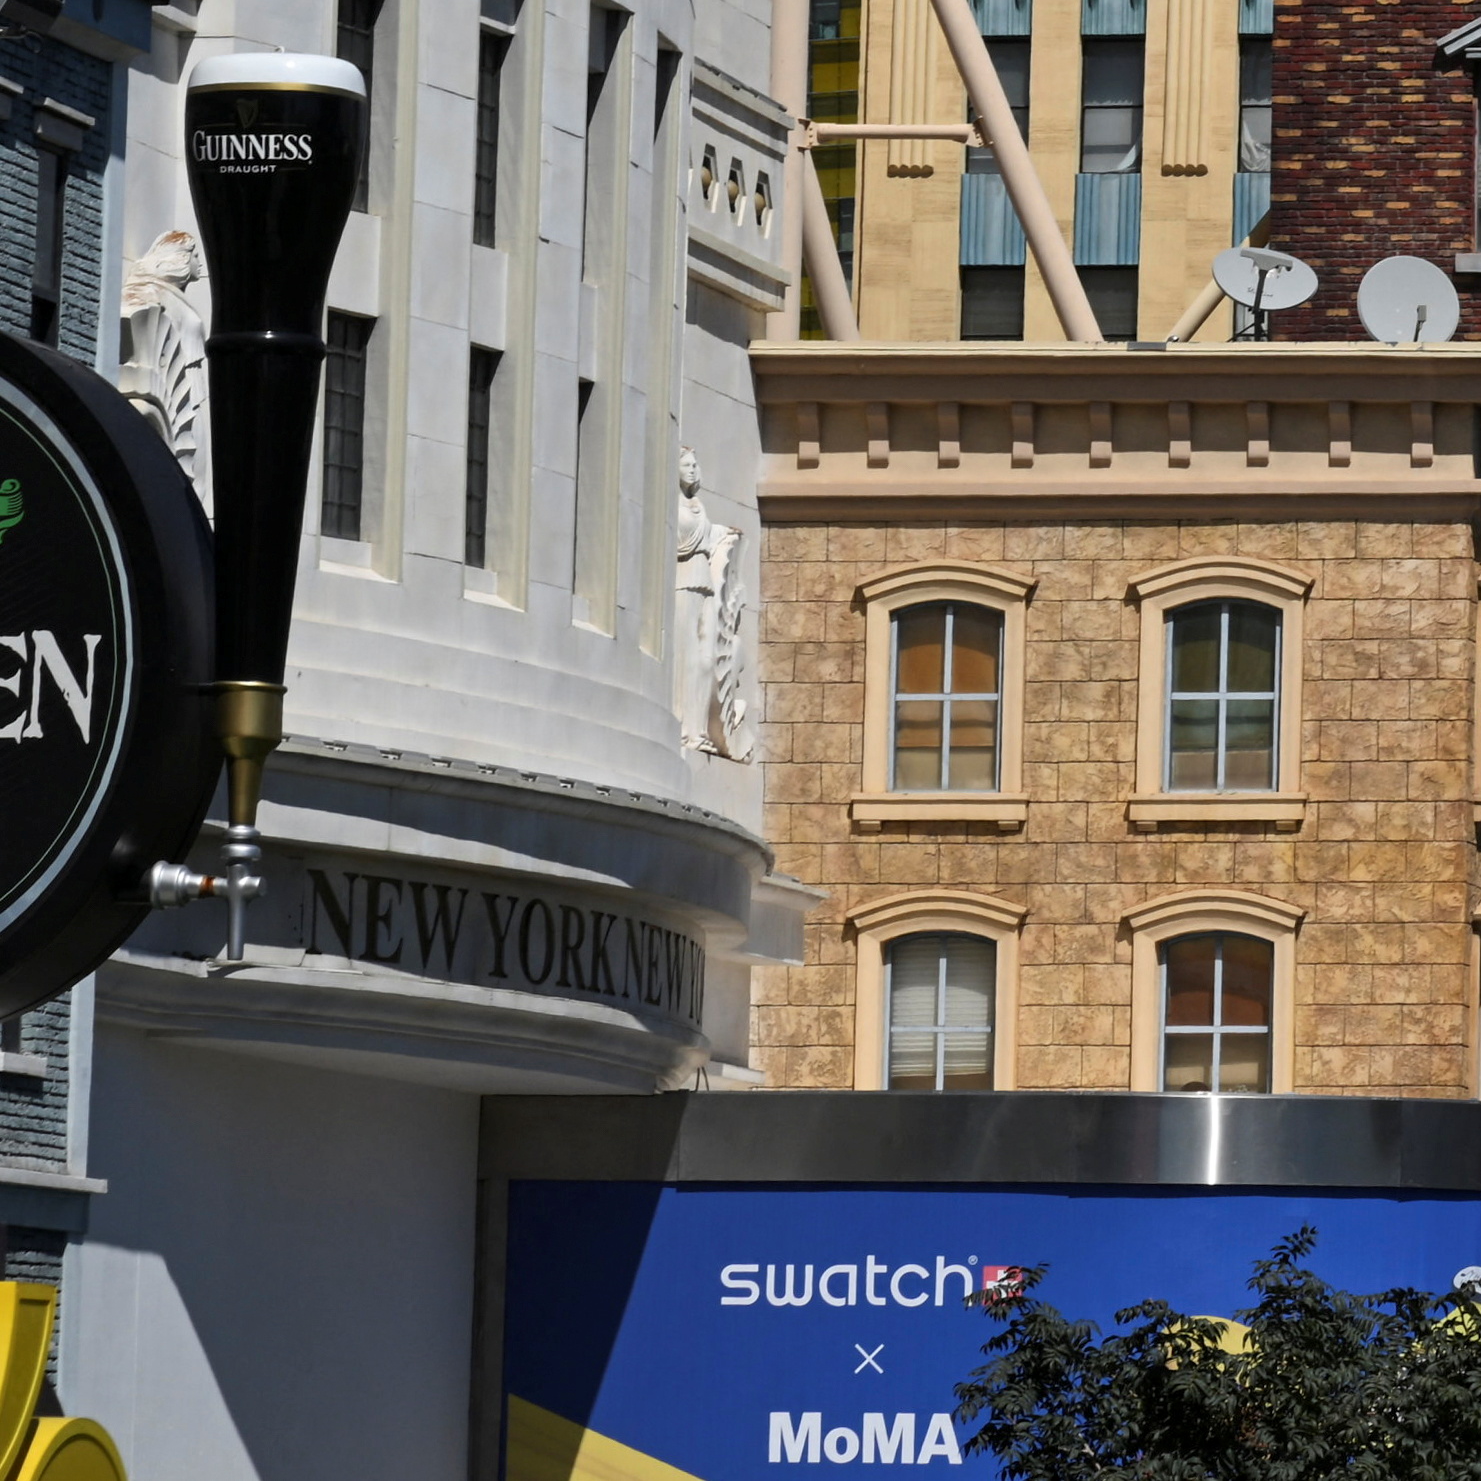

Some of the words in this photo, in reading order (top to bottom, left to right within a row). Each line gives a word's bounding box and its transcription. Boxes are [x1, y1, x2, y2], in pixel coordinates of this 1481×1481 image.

[192, 129, 313, 163] GUINNESS
[219, 164, 277, 174] DRAUGHT
[305, 868, 470, 972] NEW
[480, 891, 619, 997] YORK
[621, 916, 688, 1015] NEW
[720, 1254, 974, 1308] swatch
[768, 1411, 963, 1465] MoMA
